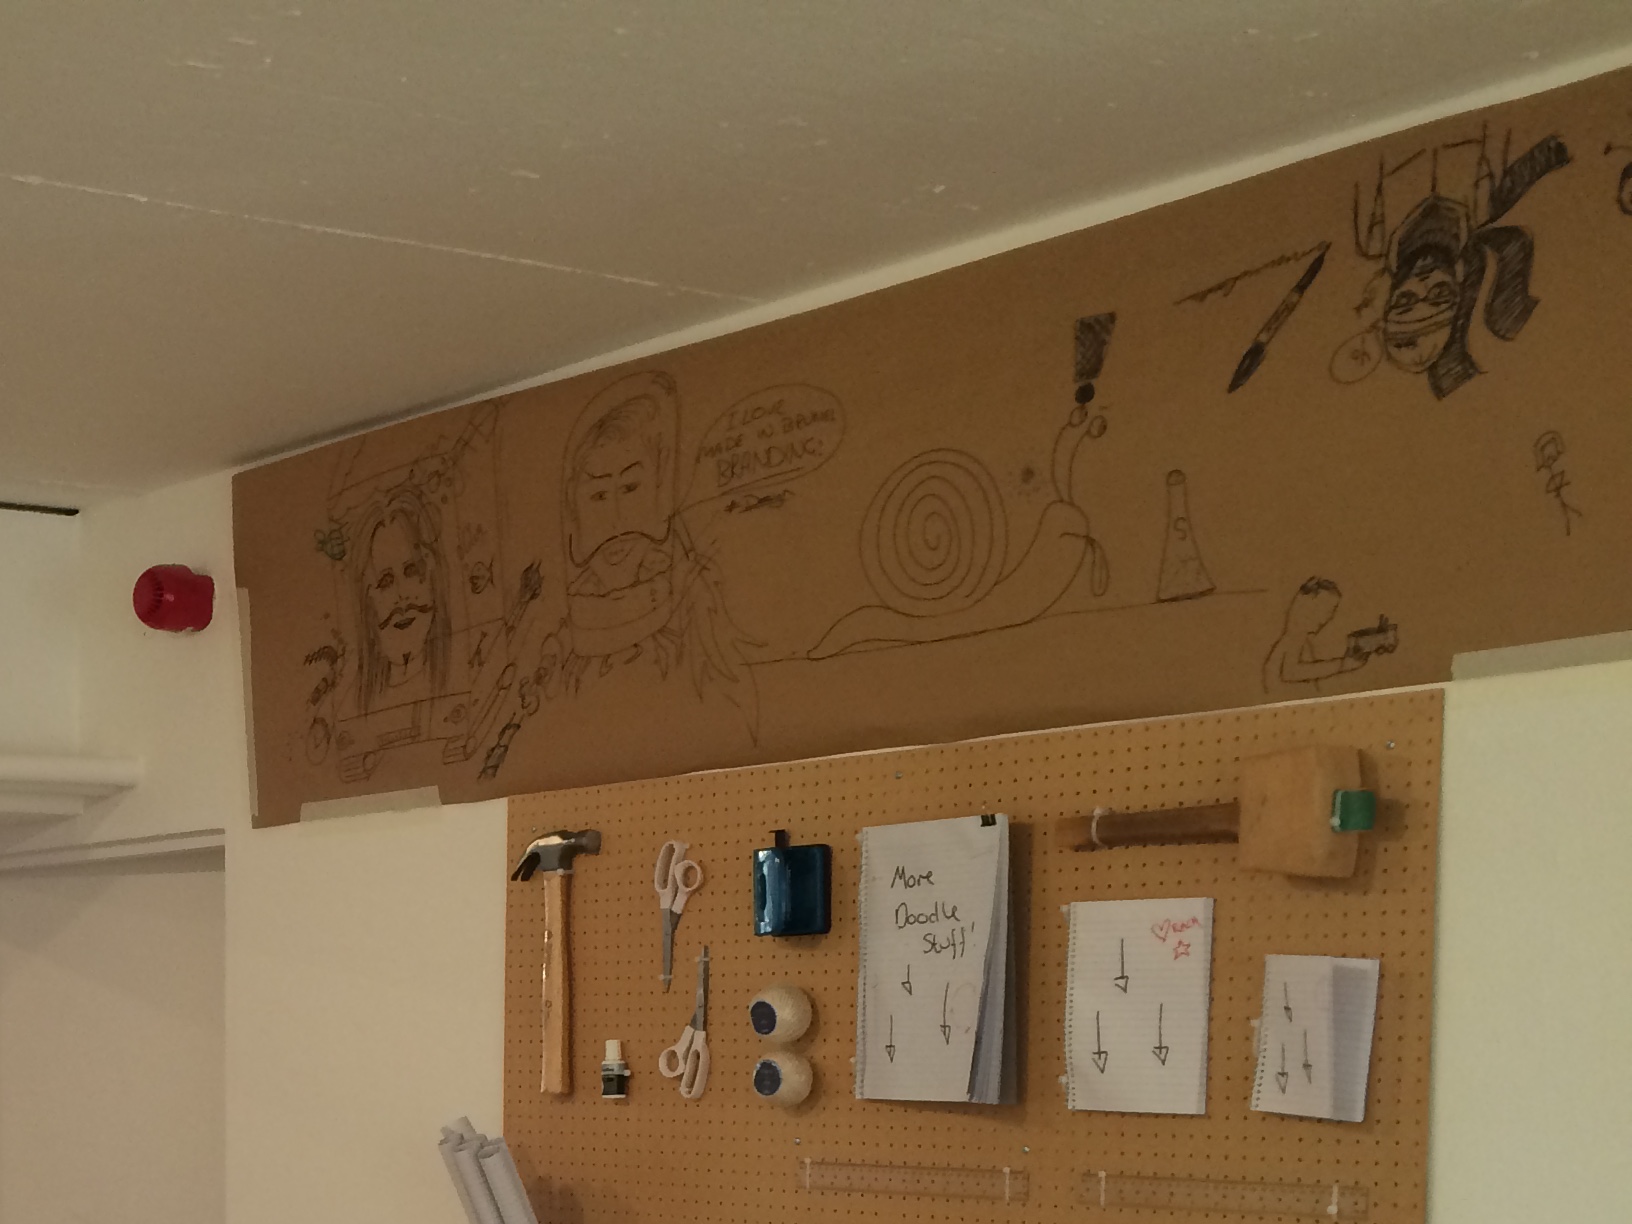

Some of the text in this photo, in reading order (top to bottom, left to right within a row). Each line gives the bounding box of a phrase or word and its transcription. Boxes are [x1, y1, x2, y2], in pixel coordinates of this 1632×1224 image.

[891, 866, 934, 889] More
[895, 902, 961, 929] Doodle
[923, 921, 976, 960] Stuff!
